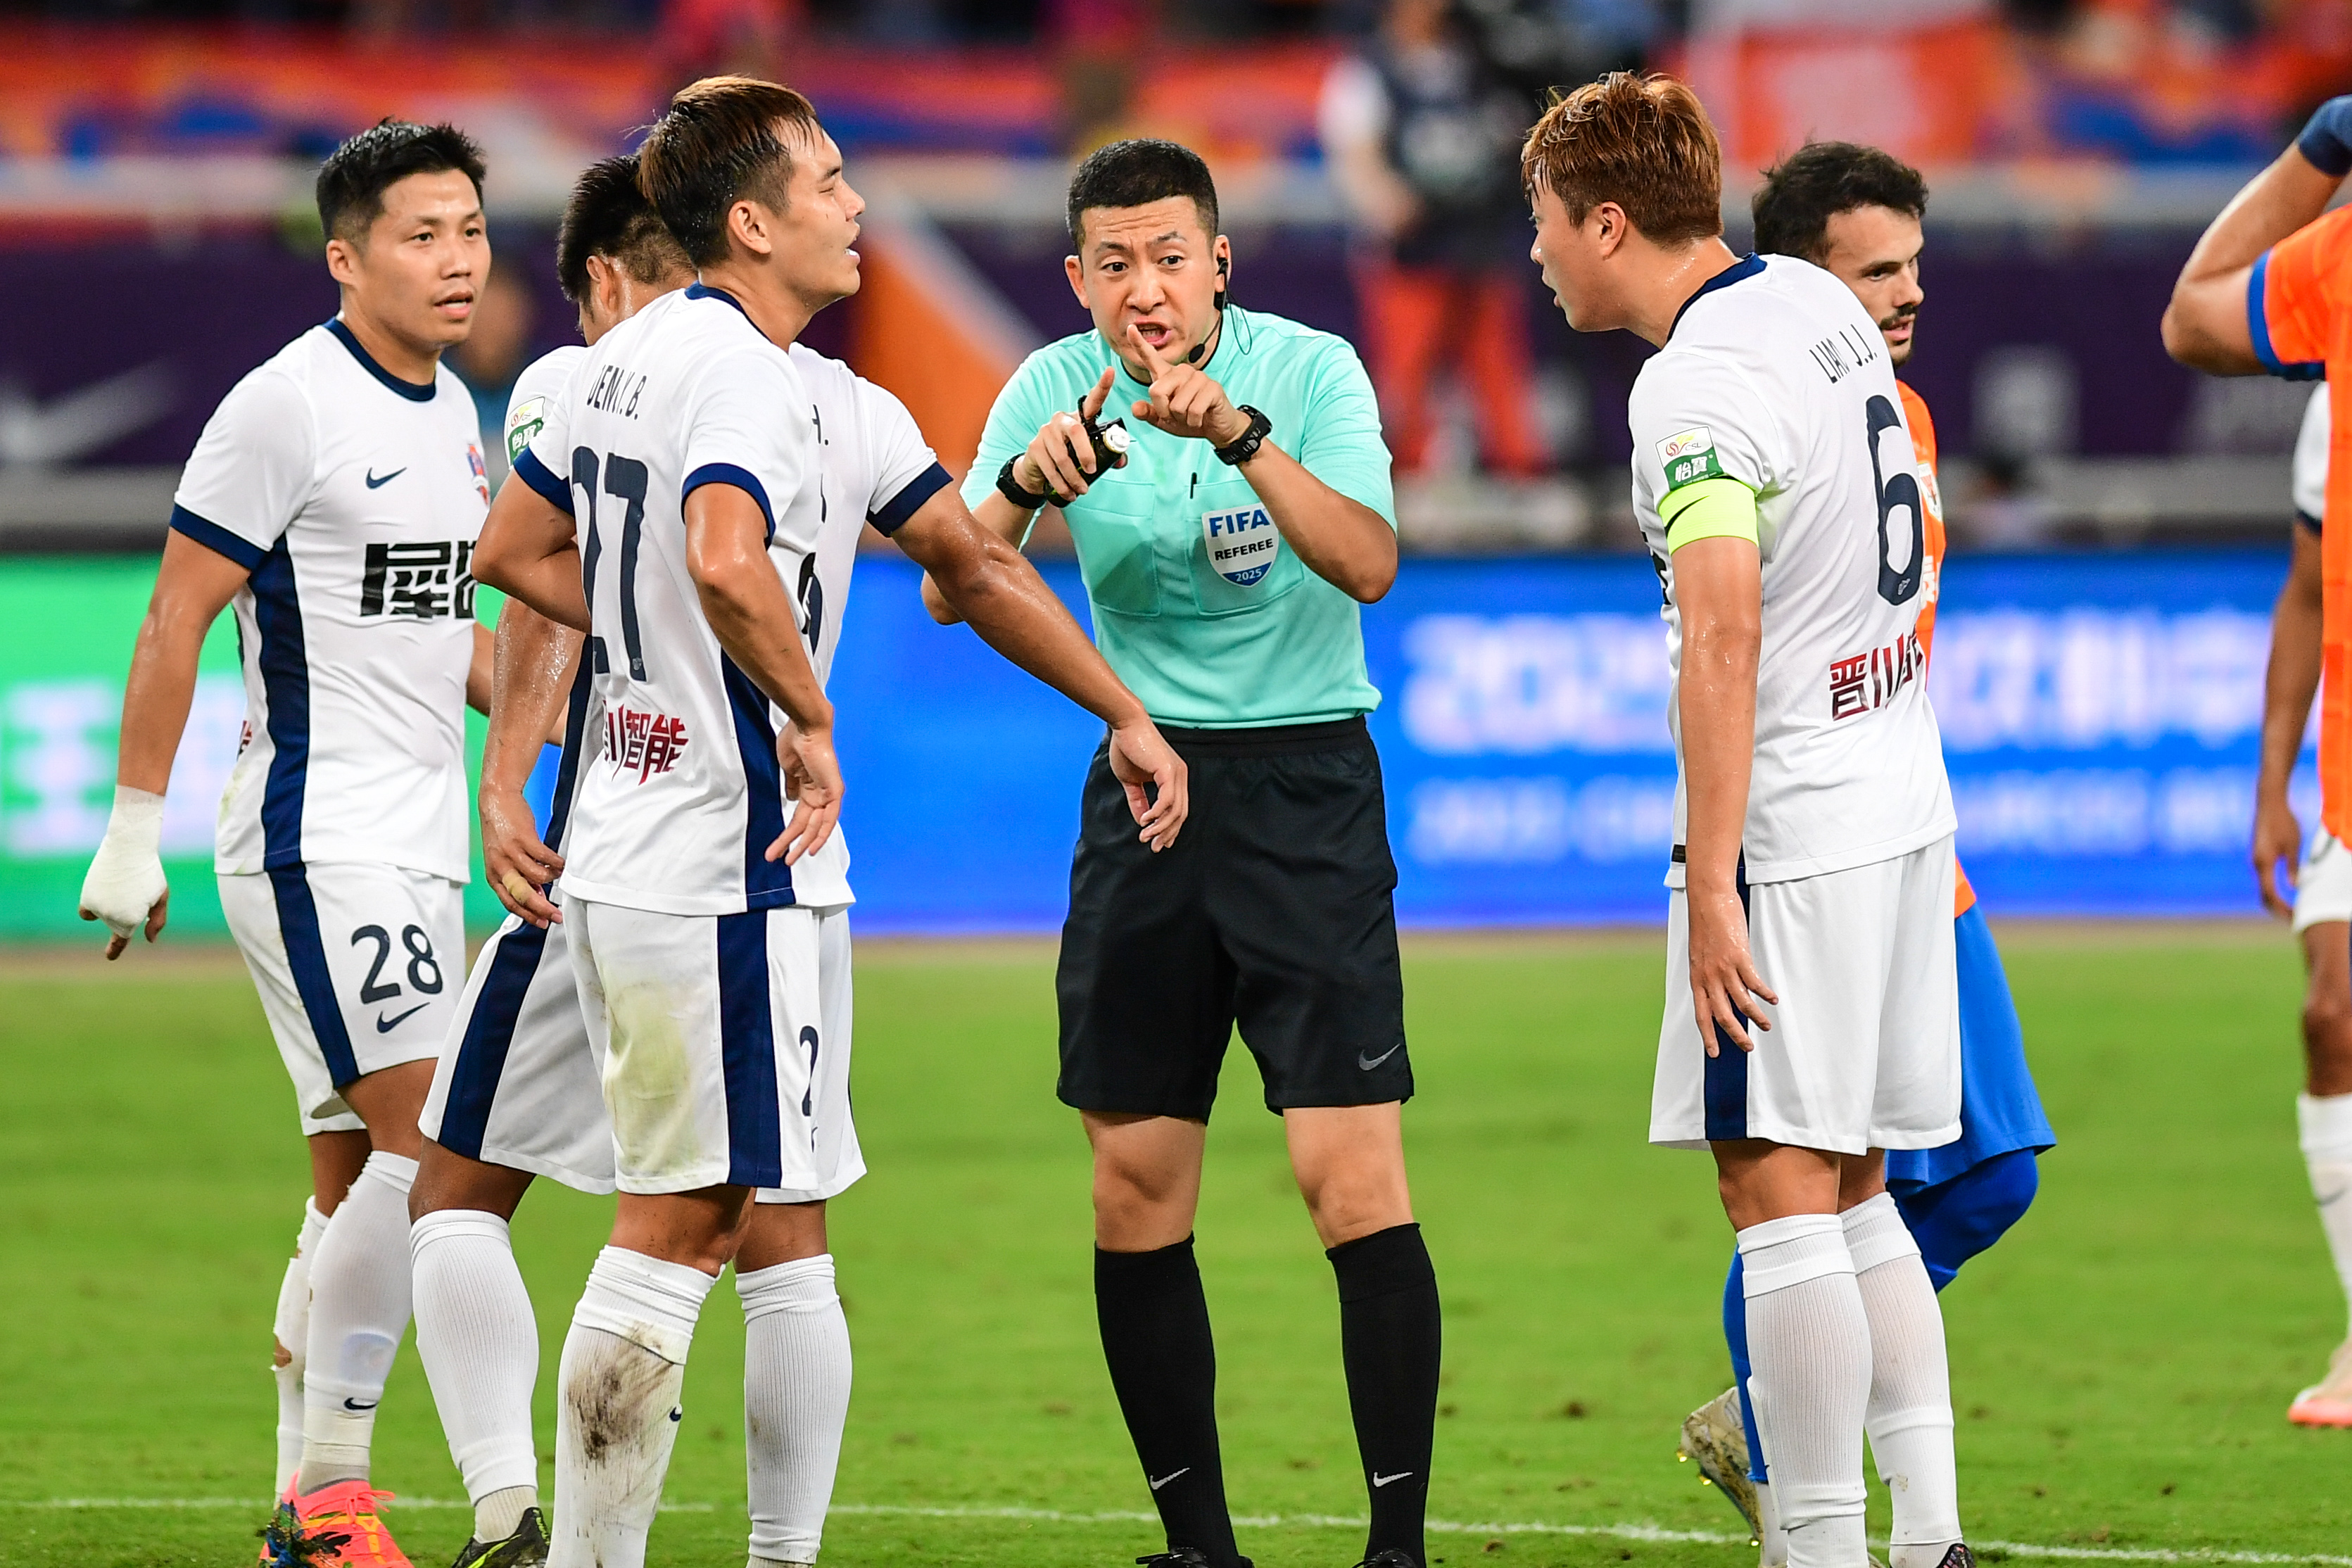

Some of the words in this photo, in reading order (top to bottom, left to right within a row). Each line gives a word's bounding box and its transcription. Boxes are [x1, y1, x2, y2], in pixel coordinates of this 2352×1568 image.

[1838, 323, 1878, 367] J.J.
[1685, 442, 1702, 451] CSL
[1209, 509, 1270, 538] FIFA
[1866, 394, 1923, 606] 6
[571, 445, 648, 682] 27
[1214, 538, 1274, 561] REFEREE
[1235, 568, 1262, 582] 2025
[602, 699, 689, 786] 川智能
[351, 924, 443, 1004] 28
[799, 1025, 819, 1117] 2
